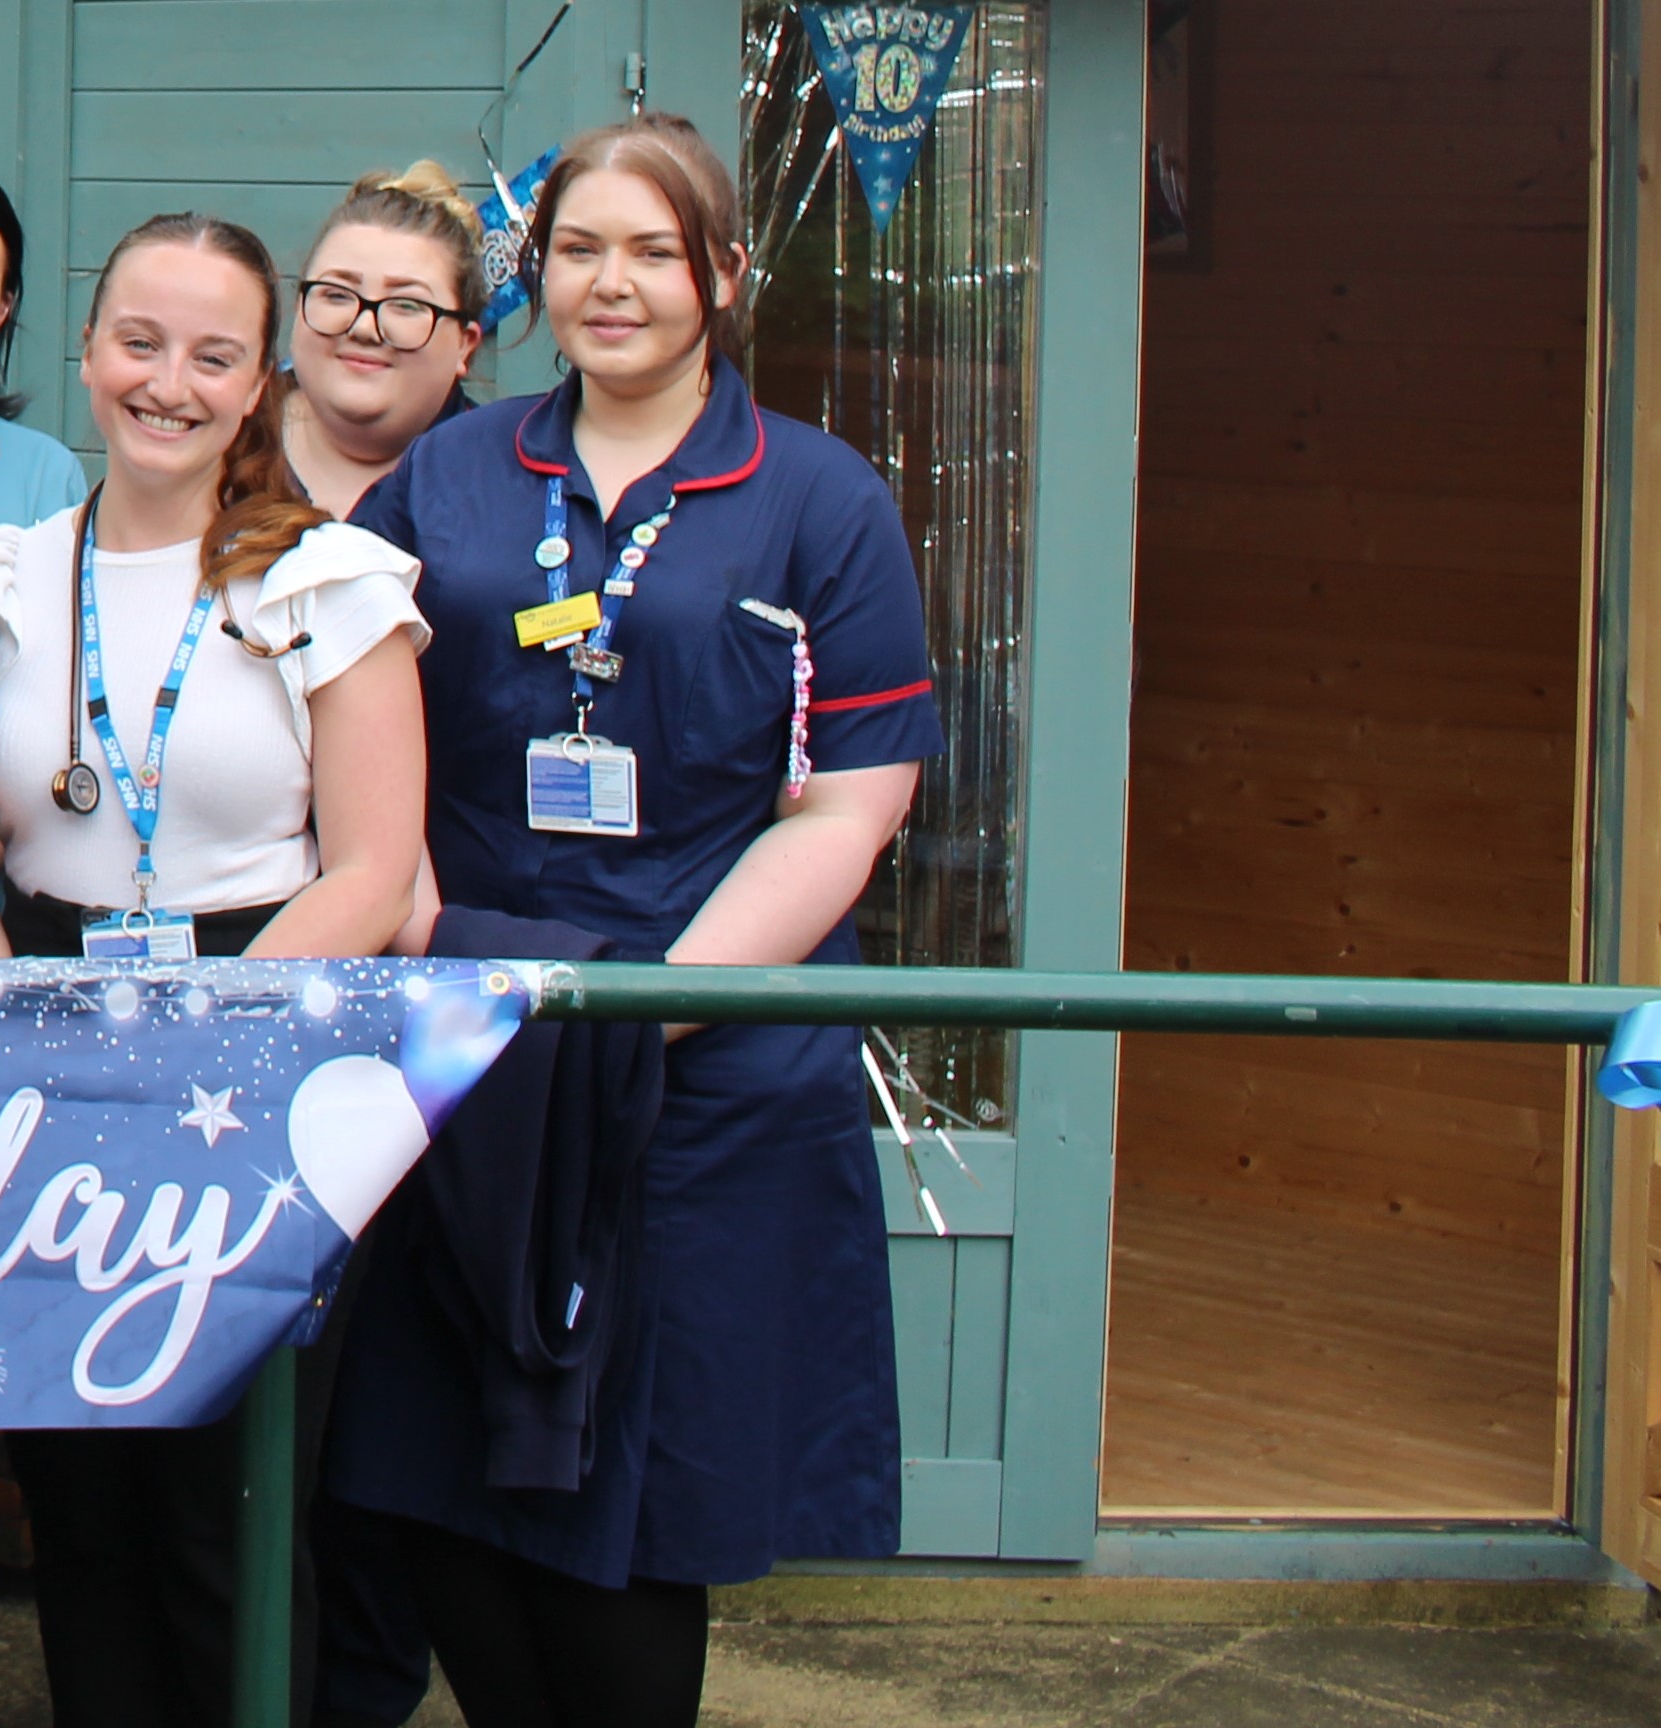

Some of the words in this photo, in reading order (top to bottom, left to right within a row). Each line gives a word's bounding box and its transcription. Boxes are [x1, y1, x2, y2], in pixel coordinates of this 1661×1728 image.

[819, 4, 954, 50] Happy
[84, 613, 97, 642] NHS
[187, 607, 206, 636] NHS
[87, 649, 100, 679] NHS
[173, 642, 193, 671] NHS
[103, 737, 125, 768] NHS
[148, 733, 163, 767] NHS
[117, 777, 140, 809] NHS
[142, 787, 156, 811] HS
